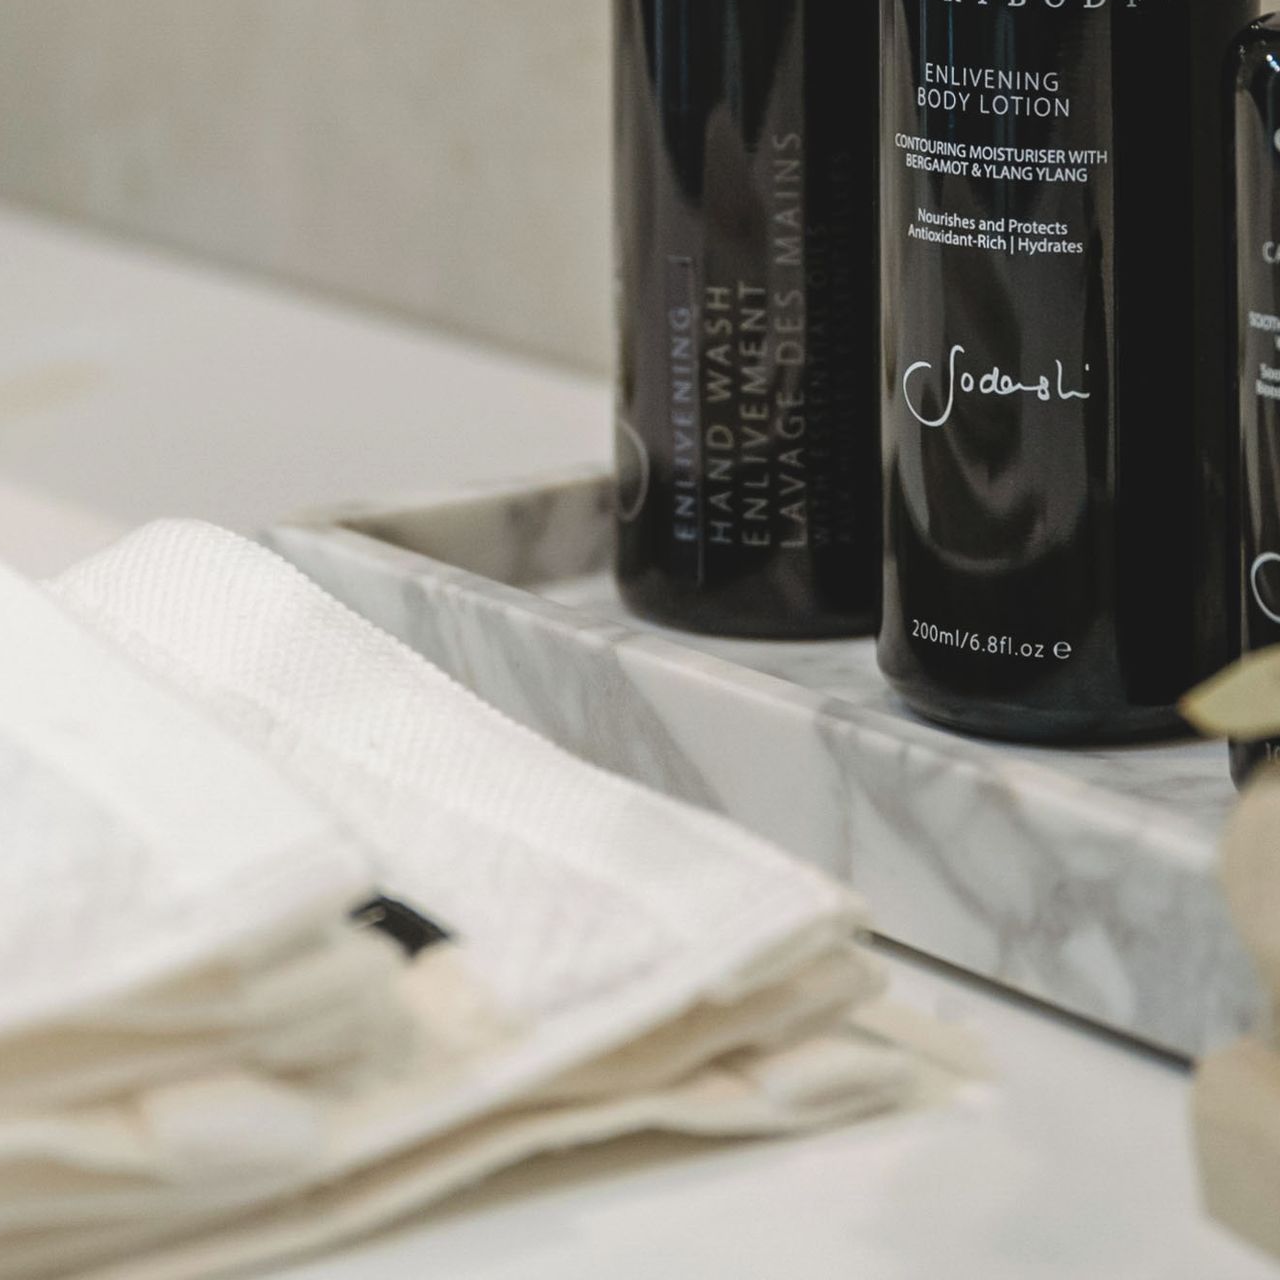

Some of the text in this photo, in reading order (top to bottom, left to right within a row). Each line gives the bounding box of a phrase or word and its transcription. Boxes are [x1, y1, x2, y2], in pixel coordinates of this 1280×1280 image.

[925, 63, 1060, 92] ENLIVENING
[917, 87, 1070, 117] BODY LOTION
[895, 133, 1108, 165] CONTOURING MOISTURISER WITH
[905, 153, 1088, 183] BERGAMOT & YLANG YLANG
[918, 207, 1068, 236] Nourishes and Protects
[908, 223, 1007, 251] Antioxidant-Rich
[1018, 237, 1084, 256] Hydrates
[772, 131, 808, 548] LAVAGE DES MAINS
[671, 306, 696, 541] ENLIVENING
[706, 285, 734, 545] HAND WASH
[738, 281, 772, 547] ENLIVEMENT
[911, 619, 1045, 659] 200ml/6.8fl.oz
